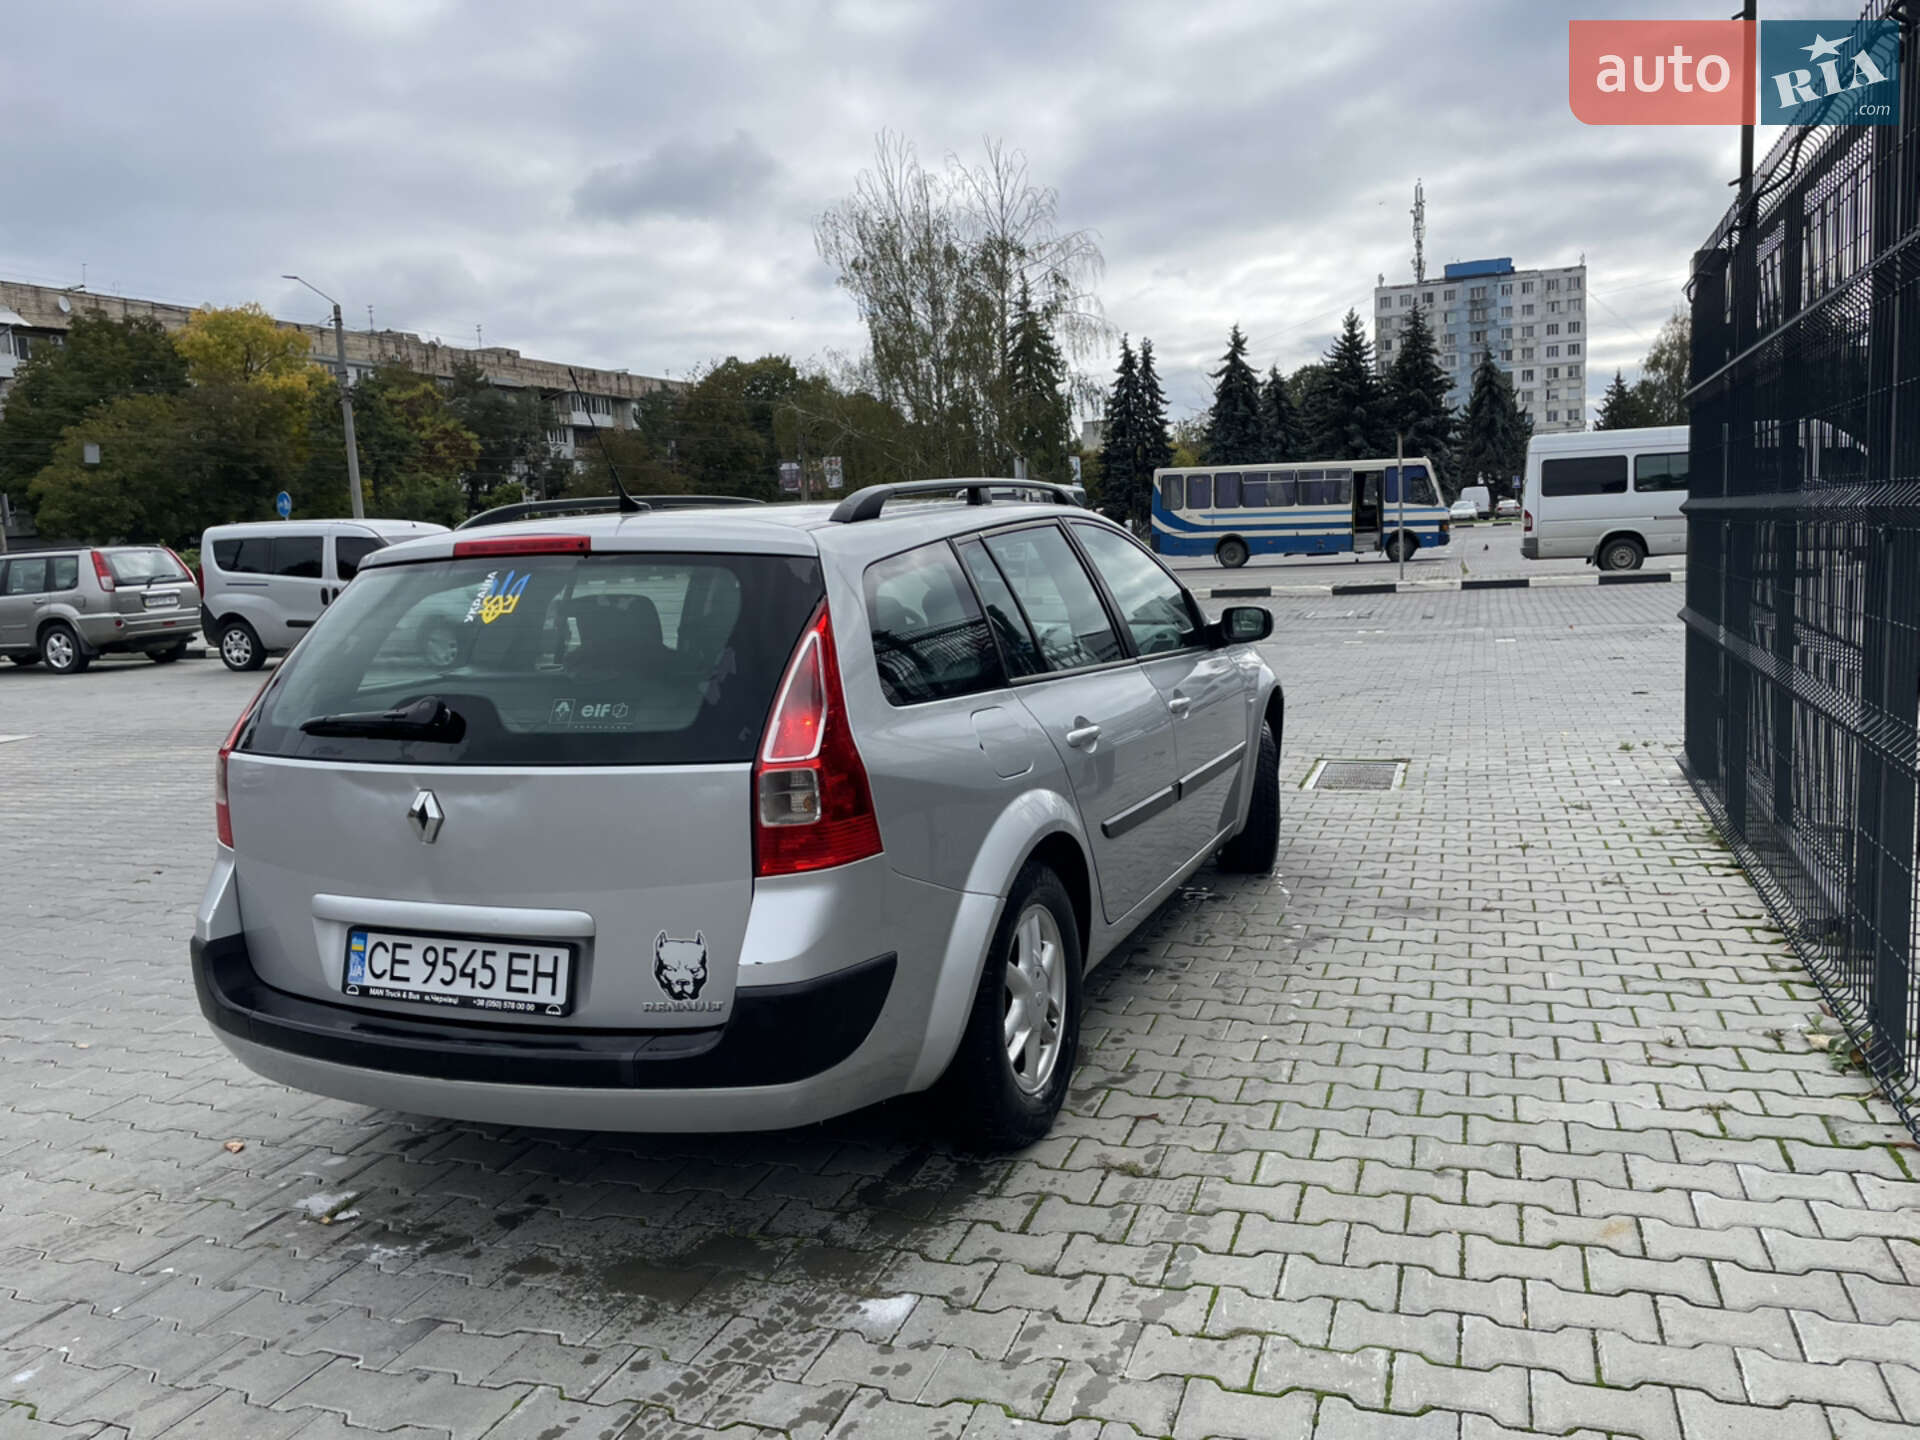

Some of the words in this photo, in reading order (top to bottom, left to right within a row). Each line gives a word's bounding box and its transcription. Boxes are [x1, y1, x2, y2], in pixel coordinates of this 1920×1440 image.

[582, 703, 612, 718] elf
[368, 941, 413, 982] CE
[422, 945, 497, 990] 9545
[506, 952, 559, 996] EH
[369, 987, 384, 997] MAN
[385, 988, 401, 999] Truck
[408, 991, 420, 1000] Bus
[643, 1001, 723, 1013] RENAULT
